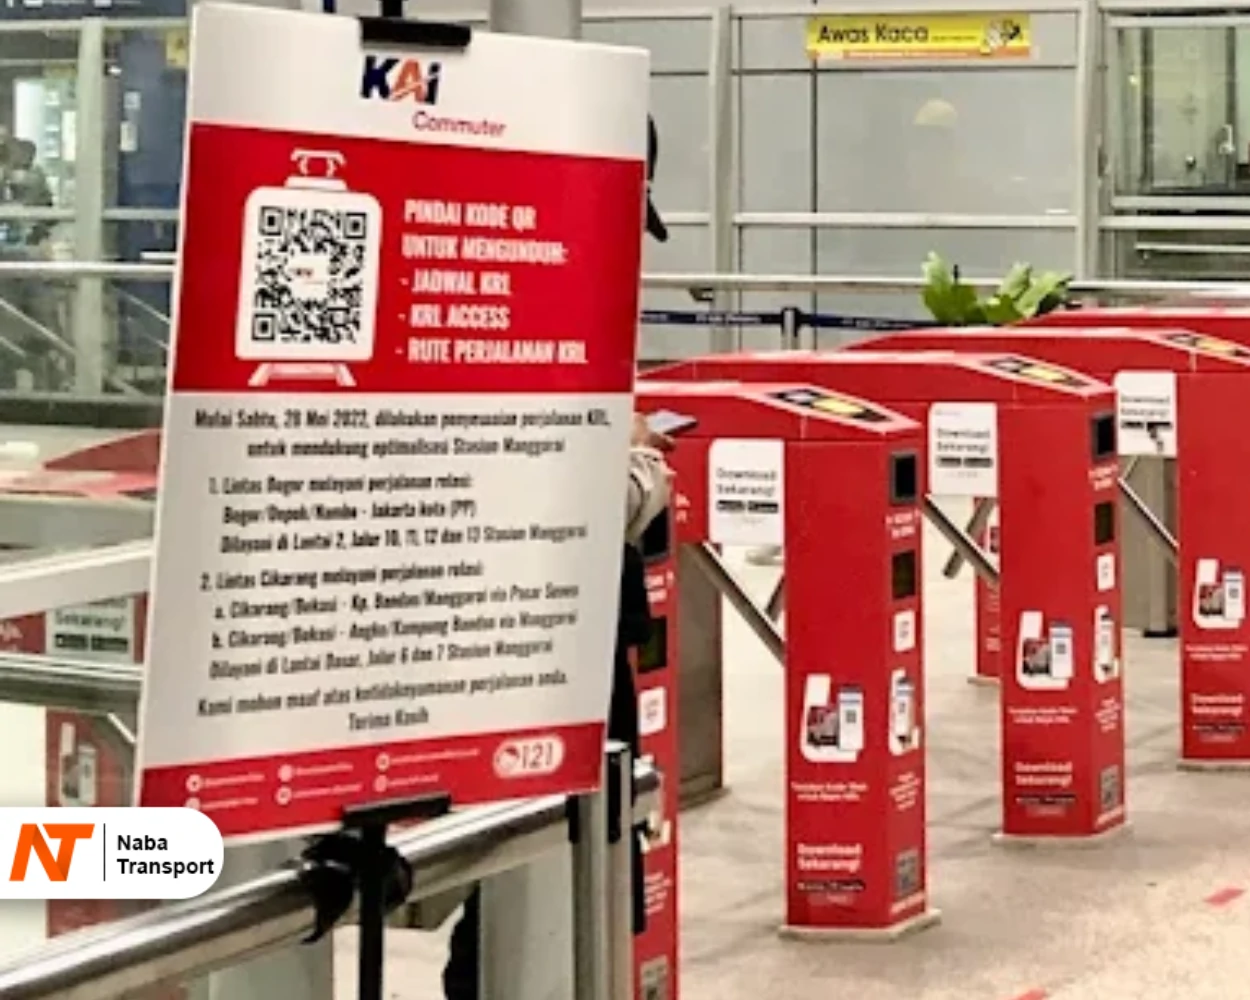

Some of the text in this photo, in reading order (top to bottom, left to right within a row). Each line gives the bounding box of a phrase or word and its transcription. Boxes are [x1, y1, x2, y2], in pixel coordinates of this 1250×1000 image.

[817, 25, 869, 43] Awas
[875, 24, 929, 43] Kaca
[412, 110, 507, 137] Commuter
[404, 198, 537, 232] PINDAI KODE QR
[402, 233, 459, 260] UNTUK
[411, 268, 477, 295] JADWAL
[479, 272, 513, 296] KRL
[410, 303, 442, 328] KRL
[446, 304, 511, 331] ACCESS
[407, 337, 452, 364] RUTE
[453, 339, 554, 365] PERJALANAN
[557, 340, 588, 365] KRL
[195, 409, 233, 428] Mulai
[333, 408, 370, 429] 2022,
[374, 409, 438, 428] dilakukan
[441, 410, 518, 430] penyesuaian
[520, 409, 583, 429] perjalanan
[248, 436, 566, 459] untuk mendukung optimalisasi Stasiun Manggarai
[222, 476, 262, 495] Lintas
[266, 475, 305, 496] Bogor
[308, 475, 363, 494] melayani
[368, 474, 432, 494] perjalanan
[716, 466, 777, 482] Download
[370, 503, 417, 520] Jakarta
[450, 499, 477, 519] (PP)
[220, 533, 273, 554] Dilayani
[276, 533, 289, 552] di
[292, 532, 332, 552] Lantai
[352, 530, 381, 549] Jalur
[441, 527, 463, 545] dan
[483, 525, 528, 543] Stasiun
[529, 523, 588, 544] Manggarai
[215, 571, 256, 590] Lintas
[259, 569, 318, 590] Cikarang
[321, 567, 377, 585] melayani
[381, 563, 444, 583] perjalanan
[452, 615, 496, 632] Bandan
[519, 611, 578, 631] Manggarai
[208, 660, 262, 681] Dilayani
[265, 656, 279, 676] di
[281, 655, 321, 675] Lantai
[367, 648, 397, 667] Jalur
[411, 646, 433, 663] dan
[447, 642, 492, 661] Stasiun
[495, 639, 553, 659] Manggarai
[197, 696, 233, 717] Kami
[235, 692, 282, 714] mohon
[323, 688, 351, 707] atas
[469, 674, 534, 695] perjalanan
[348, 706, 430, 731] Terima Kasih
[521, 743, 555, 770] 121
